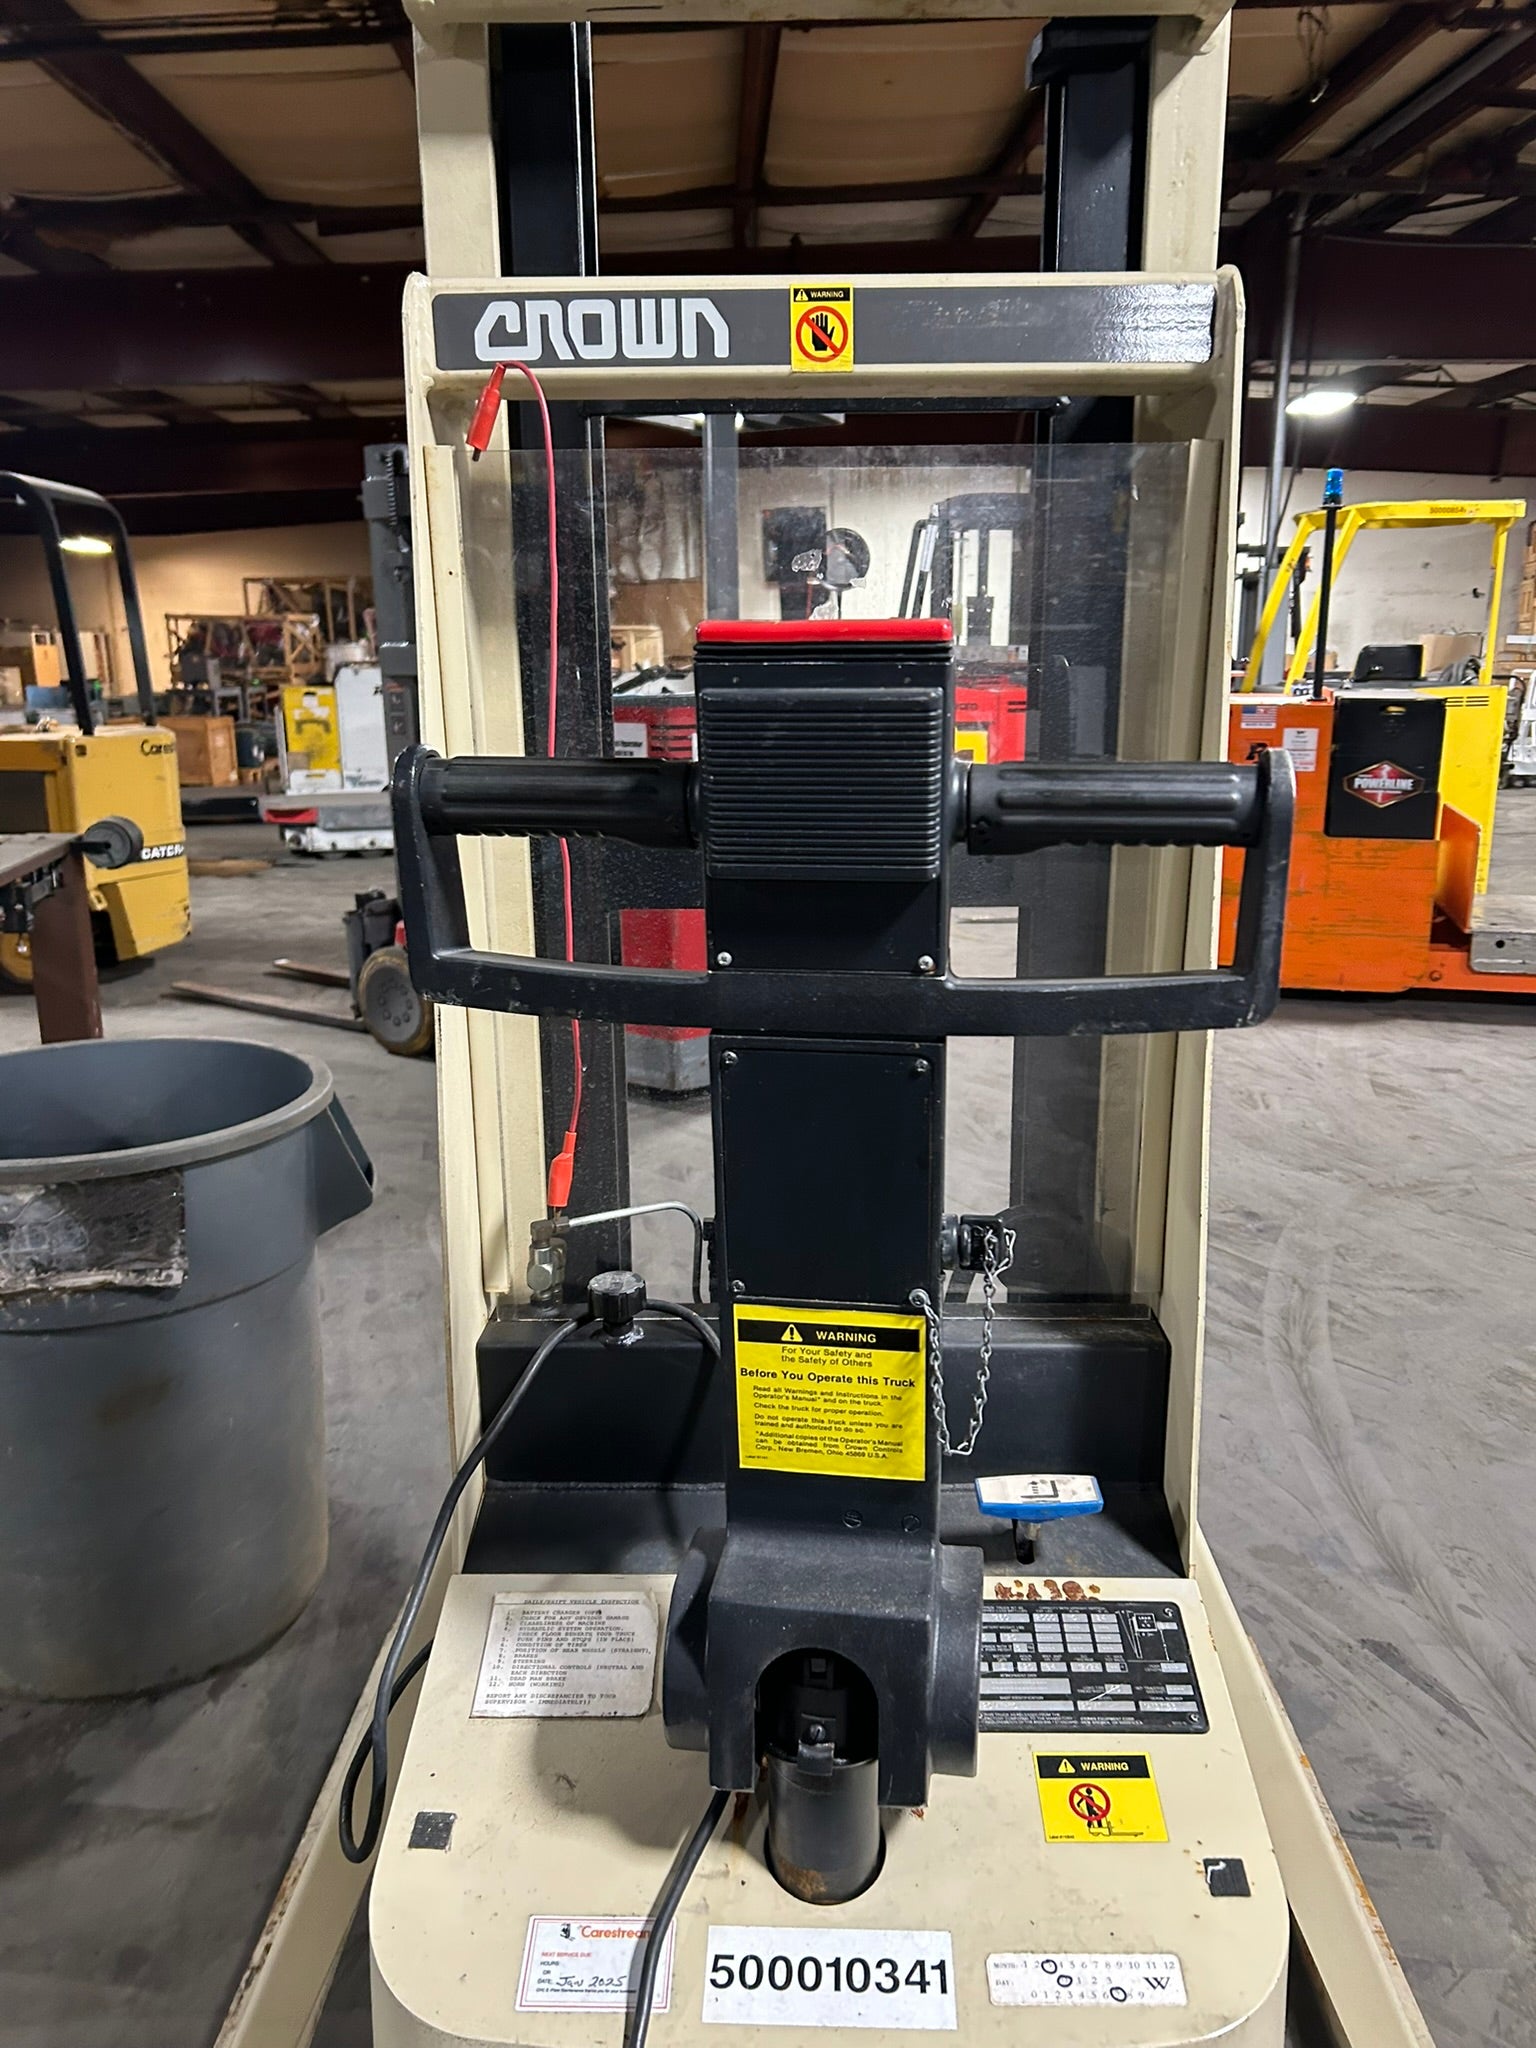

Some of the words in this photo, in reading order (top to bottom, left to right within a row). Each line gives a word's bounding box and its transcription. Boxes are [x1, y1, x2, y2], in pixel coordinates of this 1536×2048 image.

[810, 290, 845, 299] WARNING
[474, 298, 731, 362] CROWN
[1354, 777, 1415, 791] POWERLINE
[815, 1330, 877, 1344] WARNING
[782, 1346, 796, 1354] For
[800, 1347, 820, 1356] Your
[824, 1349, 852, 1358] Safety
[855, 1351, 872, 1359] and
[782, 1355, 795, 1363] the
[799, 1356, 826, 1366] Safety
[842, 1359, 872, 1367] Others
[740, 1368, 777, 1378] Before
[781, 1370, 803, 1381] You
[807, 1372, 852, 1385] Operate
[857, 1376, 878, 1385] this
[883, 1377, 915, 1388] Truck
[785, 1387, 817, 1396] Warnings
[836, 1391, 878, 1400] Instructions
[754, 1402, 775, 1410] Check
[791, 1404, 808, 1412] truck
[824, 1407, 846, 1415] proper
[849, 1408, 883, 1417] operation.
[782, 1415, 808, 1423] operate
[828, 1418, 845, 1426] truck
[850, 1419, 872, 1427] unless
[795, 1423, 832, 1432] authorized
[796, 1434, 817, 1442] copies
[788, 1440, 817, 1448] obtained
[845, 1443, 867, 1451] Crown
[873, 1445, 903, 1453] Controls
[1080, 1761, 1129, 1771] WARNING
[588, 1975, 627, 1987] 2025
[709, 1954, 948, 1995] 500010341
[1143, 1977, 1170, 1990] W
[1055, 1991, 1061, 1999] 2
[1067, 1991, 1073, 1999] 3
[1079, 1991, 1085, 1999] 4
[1091, 1991, 1097, 1999] 5
[1103, 1991, 1109, 1999] 6
[1138, 1991, 1144, 1999] 9
